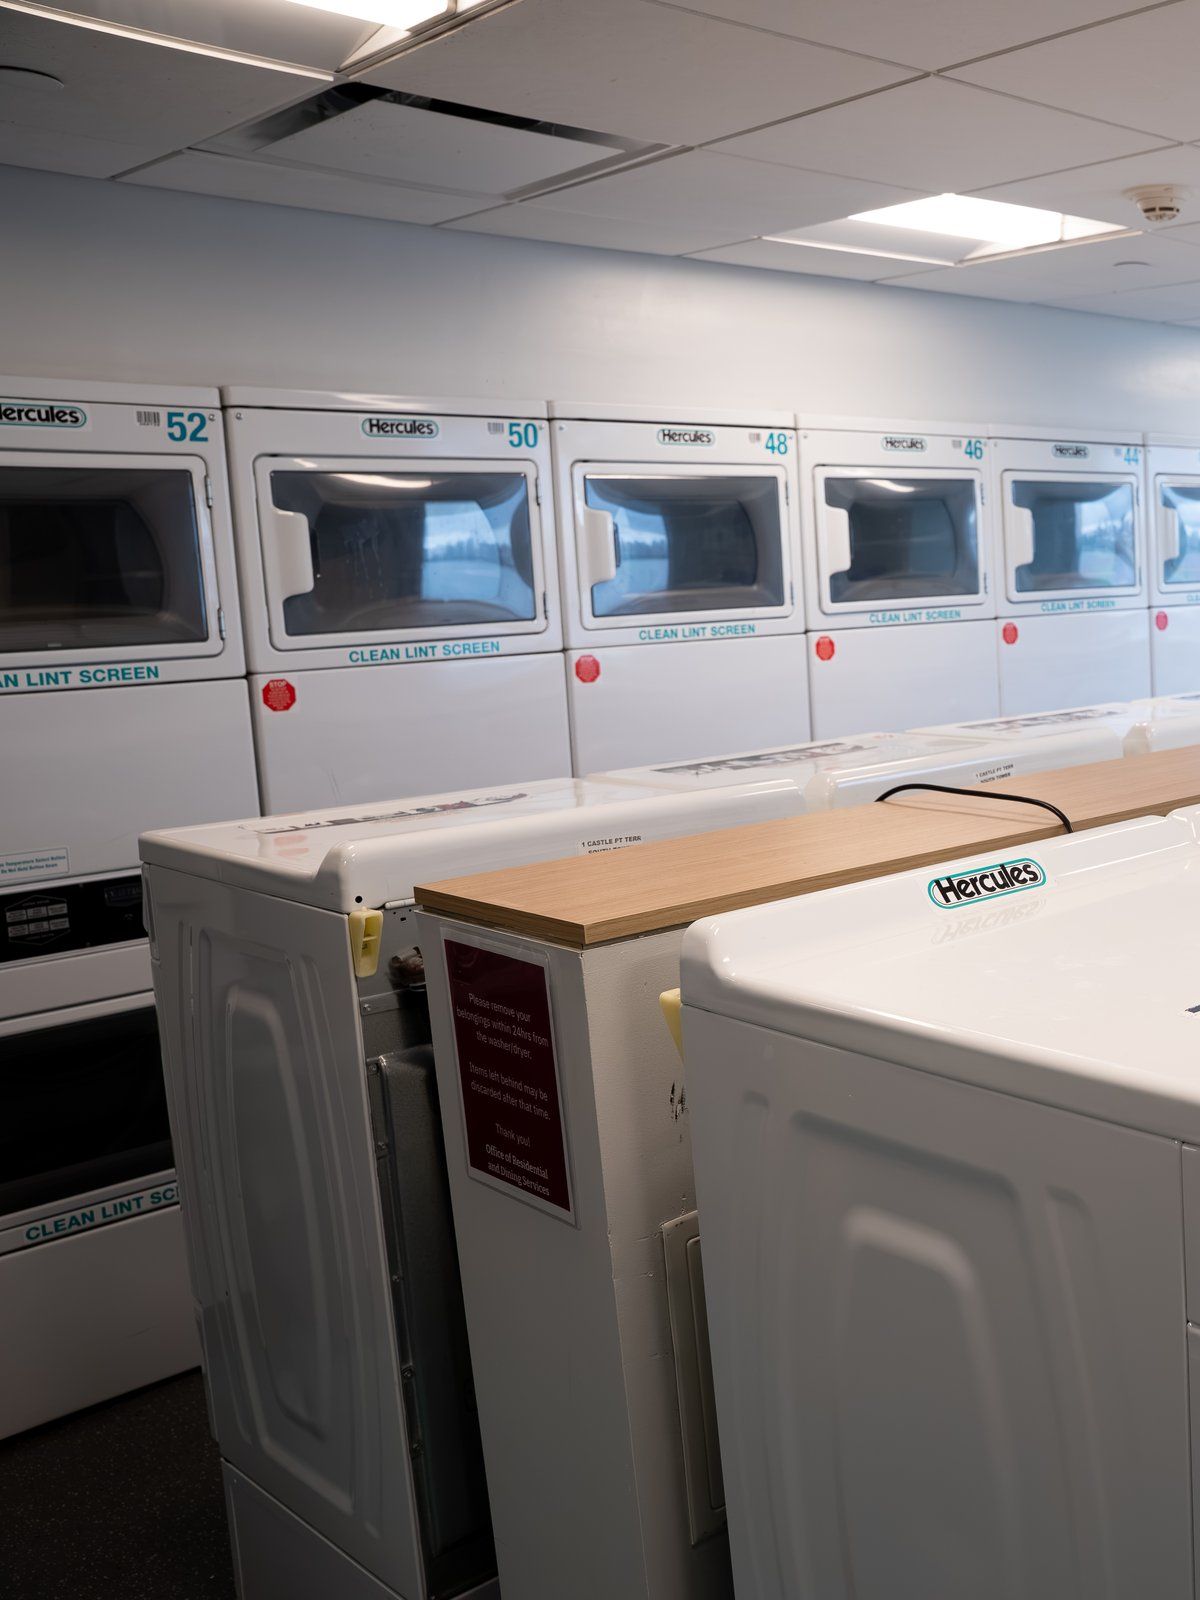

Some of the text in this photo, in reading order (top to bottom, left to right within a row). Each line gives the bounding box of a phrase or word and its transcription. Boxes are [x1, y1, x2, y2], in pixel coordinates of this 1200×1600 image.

[0, 406, 79, 424] ercules
[167, 412, 208, 442] 52
[368, 418, 434, 435] Hercules
[508, 423, 538, 448] 50
[661, 429, 711, 444] Hercules
[765, 433, 788, 455] 48
[885, 438, 924, 450] Hercules
[965, 440, 983, 460] 46
[1121, 447, 1139, 465] 44
[869, 609, 961, 623] CLEAN LINT SCREEN
[639, 624, 756, 641] CLEAN LINT SCREEN
[348, 641, 501, 664] CLEAN LINT SCREEN
[26, 671, 72, 687] LINT
[79, 666, 160, 684] SCREEN
[587, 839, 612, 847] CASTLE
[625, 835, 642, 843] TERR
[934, 864, 1040, 904] Hercules
[468, 992, 531, 1023] Please remove your
[456, 1007, 550, 1048] belongings within 24hrs from
[476, 1031, 532, 1060] the washer/dryer.
[469, 1062, 549, 1101] Items left behind may be
[470, 1080, 551, 1121] discarded after that time.
[495, 1122, 516, 1141] Thank
[485, 1143, 548, 1179] Office of Residential
[488, 1162, 550, 1196] and Dining Services
[25, 1210, 95, 1241] CLEAN
[102, 1197, 144, 1220] LINT
